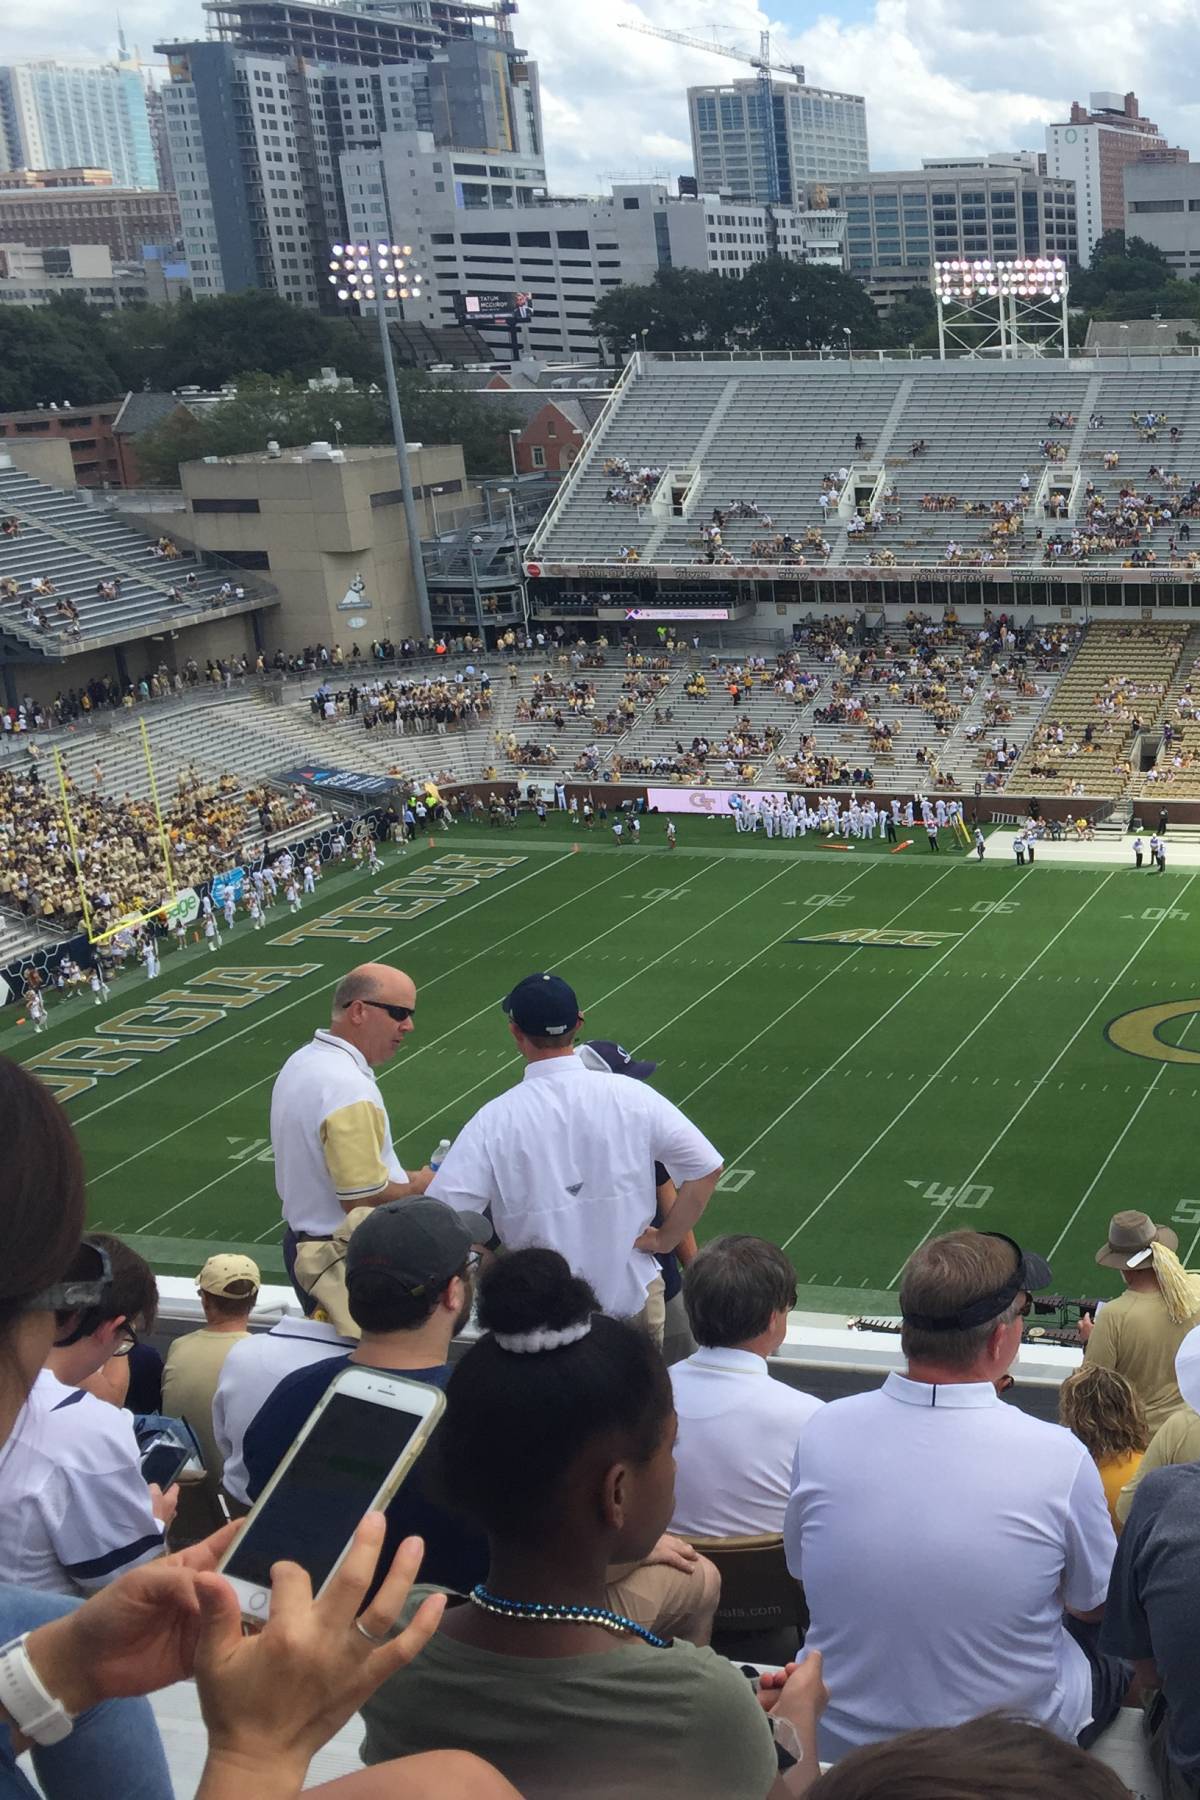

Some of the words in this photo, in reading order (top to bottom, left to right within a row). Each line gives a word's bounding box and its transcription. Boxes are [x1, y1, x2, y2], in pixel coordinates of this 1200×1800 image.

[626, 570, 657, 578] FAME
[911, 573, 940, 582] HALL
[943, 573, 958, 582] OF
[961, 573, 993, 582] FAME
[1012, 575, 1062, 583] BAUGHAN
[1151, 576, 1182, 584] DAVIS
[264, 852, 529, 947] TECH
[793, 928, 964, 947] ACC
[922, 1182, 995, 1210] 40
